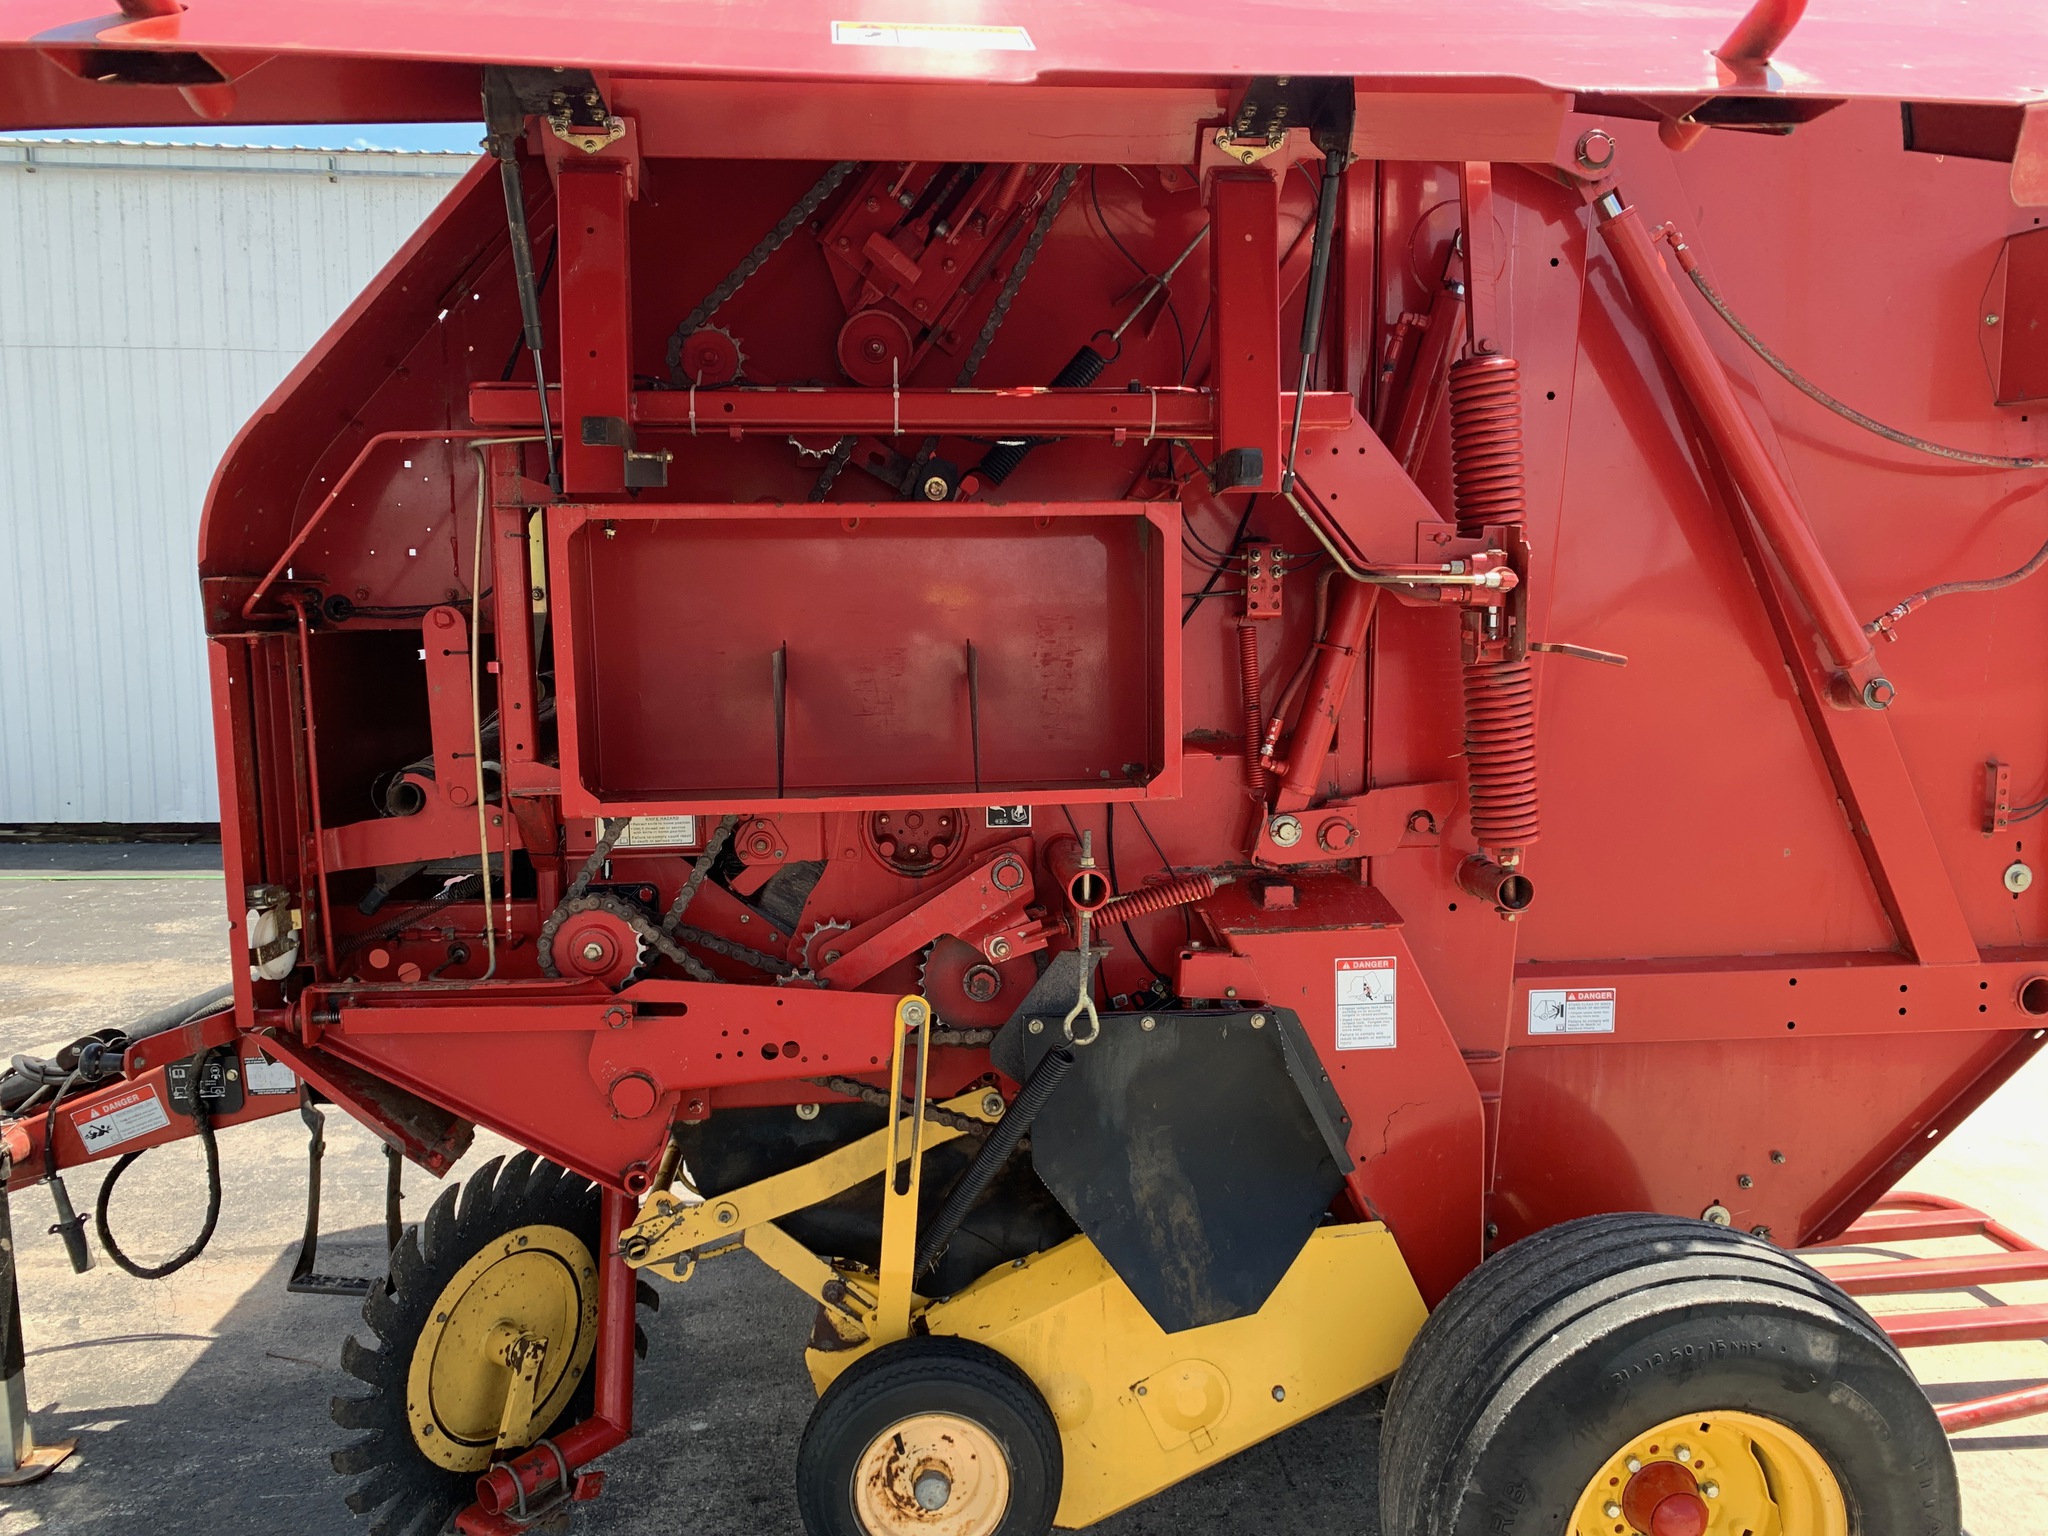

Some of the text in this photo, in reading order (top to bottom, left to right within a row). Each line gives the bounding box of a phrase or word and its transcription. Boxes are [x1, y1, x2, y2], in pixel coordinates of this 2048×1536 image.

[1352, 960, 1389, 969] DANGER
[1578, 992, 1612, 1000] DANGER
[102, 1094, 139, 1112] DANGER
[1488, 1481, 1527, 1536] RIB
